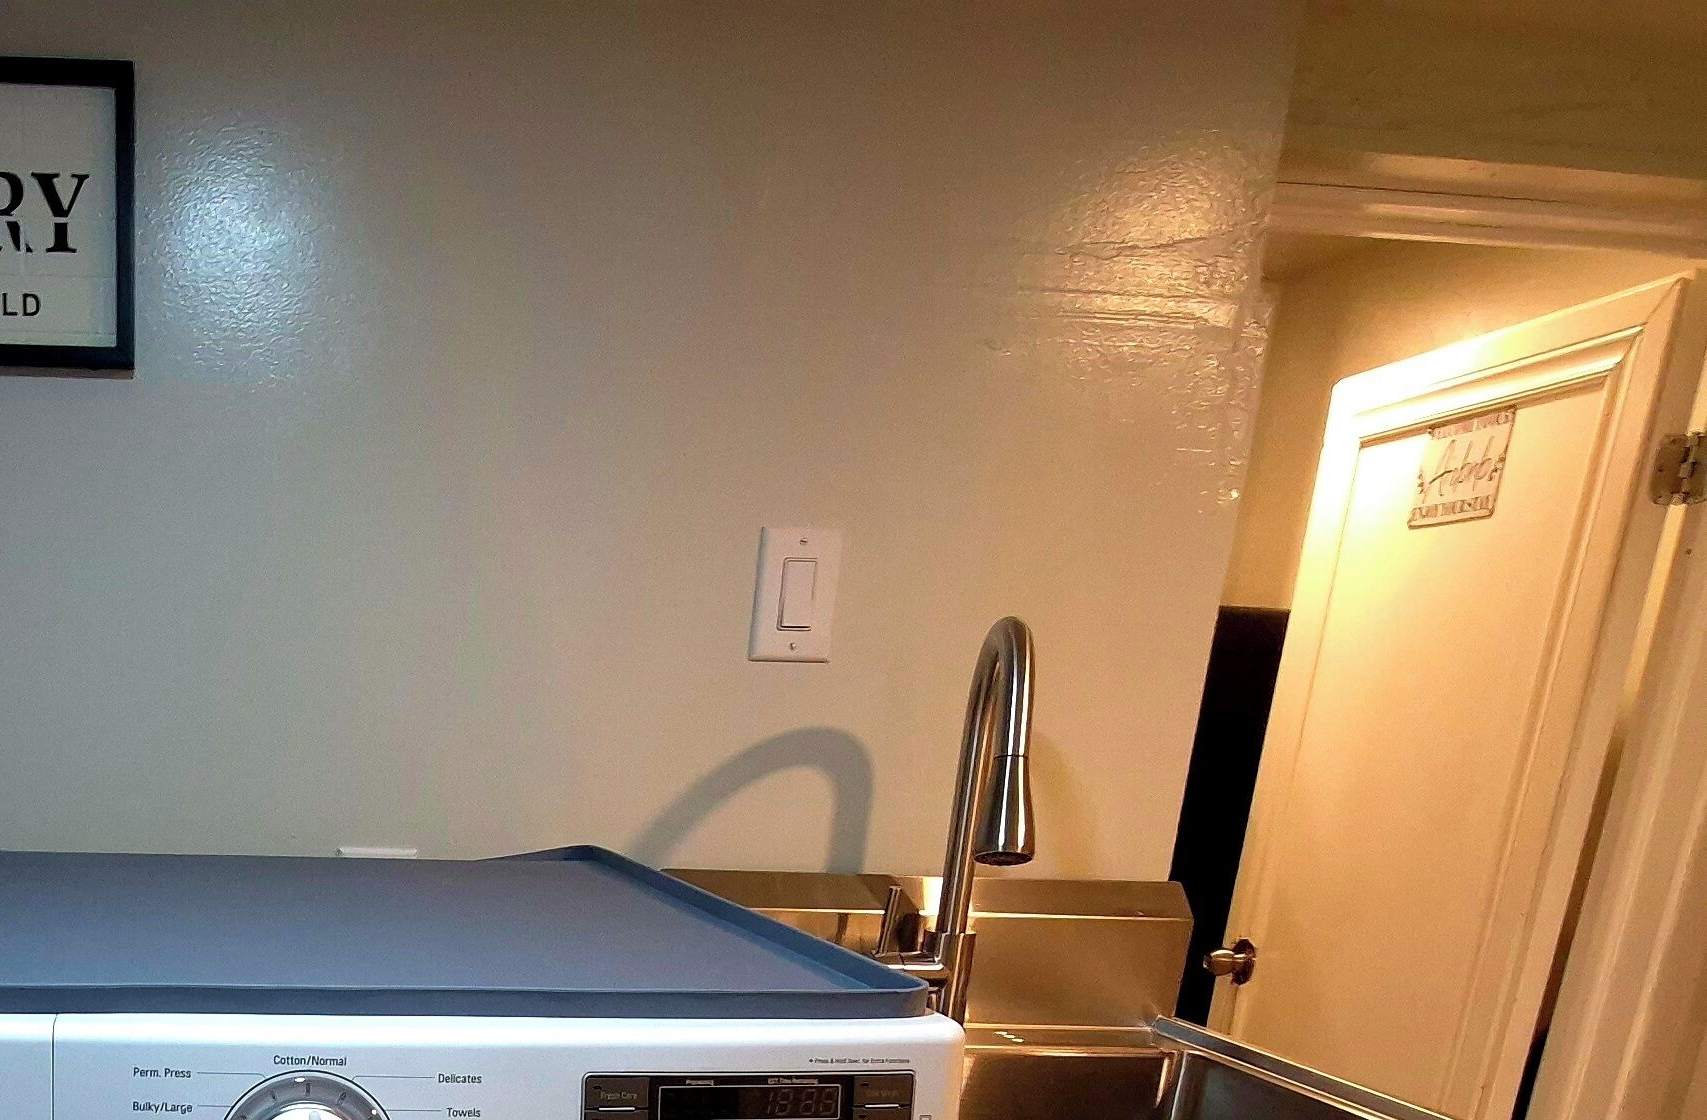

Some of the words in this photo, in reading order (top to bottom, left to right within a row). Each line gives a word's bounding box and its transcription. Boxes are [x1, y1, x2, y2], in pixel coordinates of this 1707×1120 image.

[273, 1054, 348, 1067] Cotton/Normal
[133, 1066, 162, 1078] Perm.
[164, 1067, 192, 1078] Press
[438, 1073, 482, 1084] Delicates
[132, 1101, 193, 1115] Bulky/Large
[446, 1107, 481, 1118] Towels
